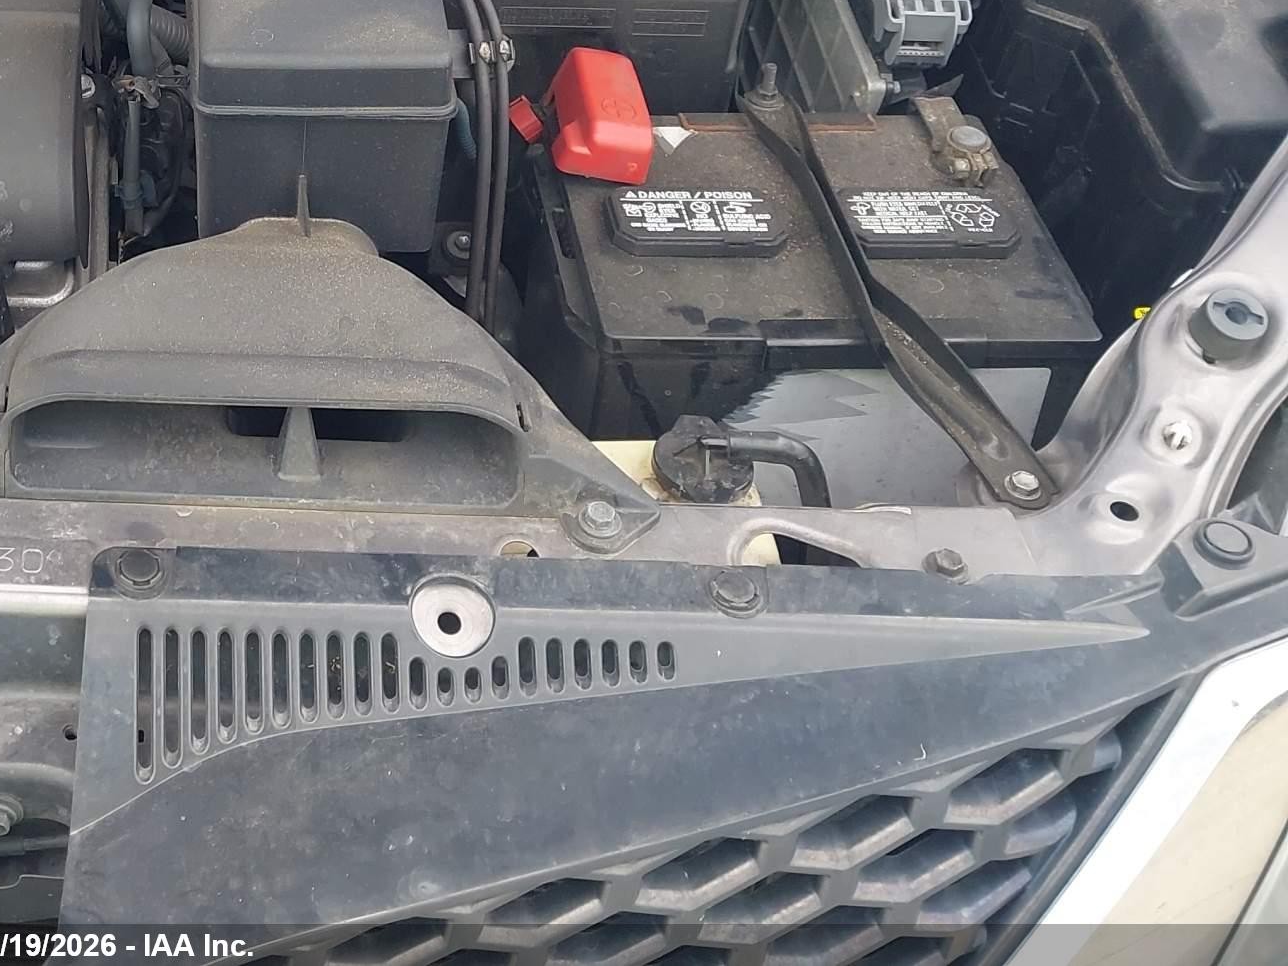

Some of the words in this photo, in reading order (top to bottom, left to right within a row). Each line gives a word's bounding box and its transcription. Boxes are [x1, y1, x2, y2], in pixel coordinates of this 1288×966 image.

[638, 190, 691, 199] DANGER
[693, 191, 701, 199] /
[703, 191, 753, 200] POISON
